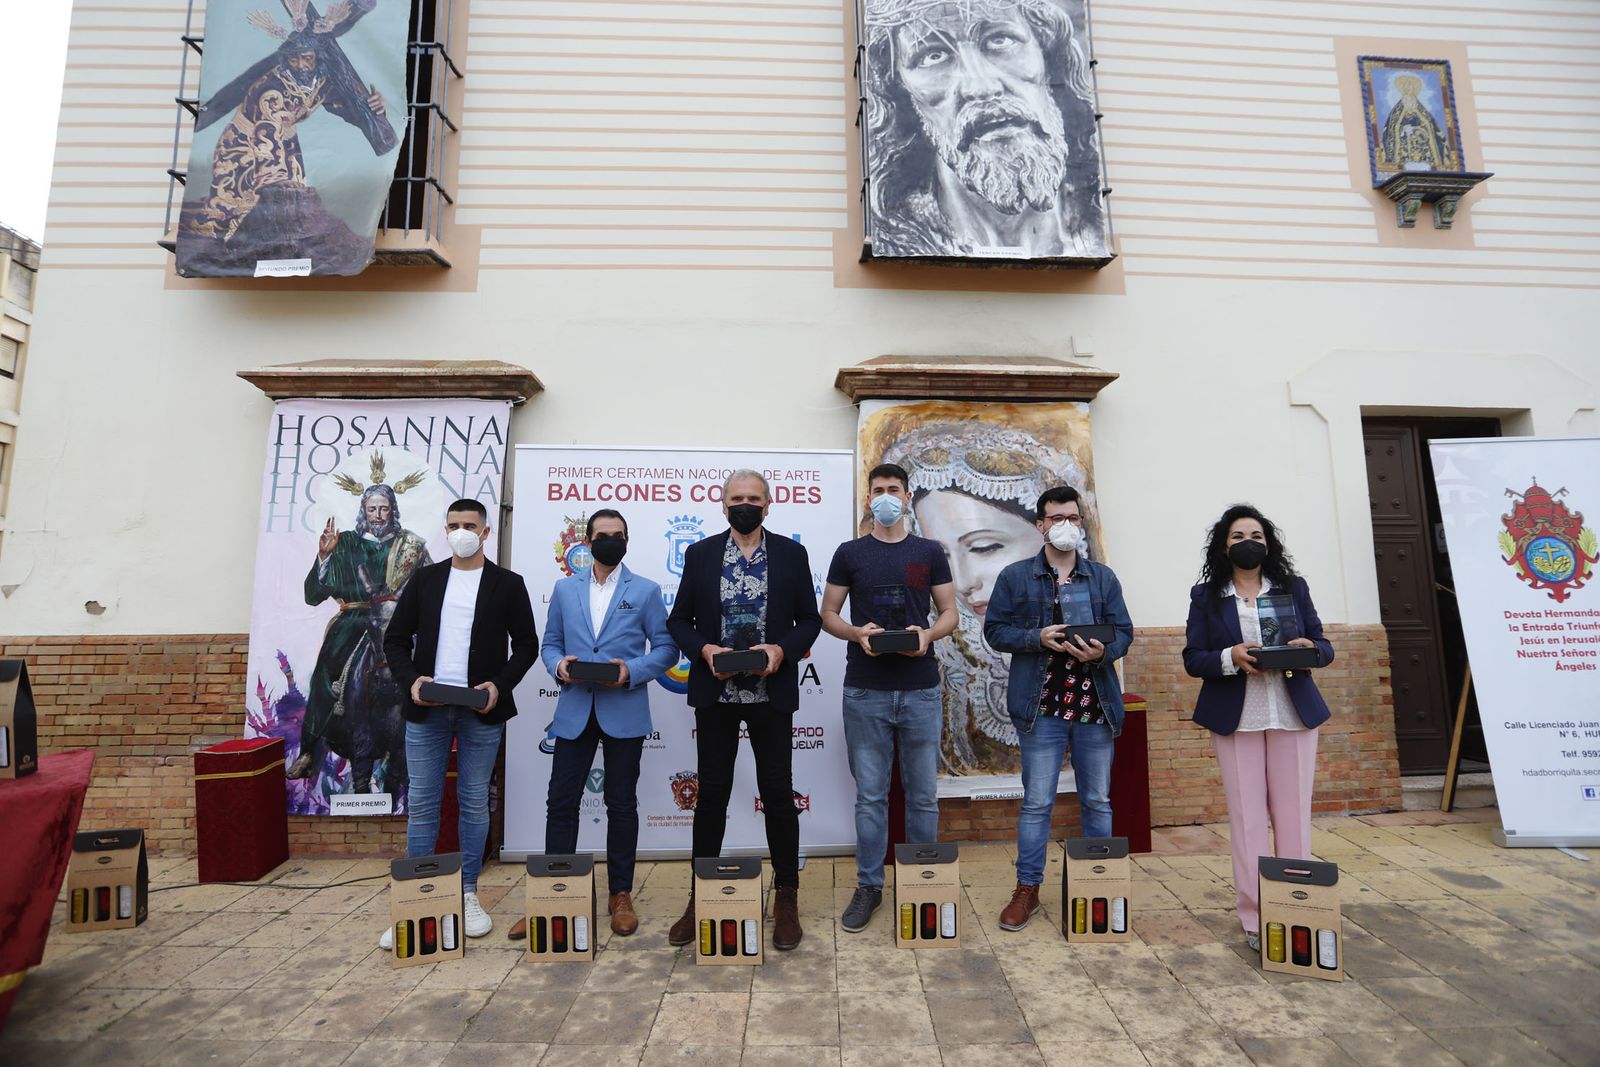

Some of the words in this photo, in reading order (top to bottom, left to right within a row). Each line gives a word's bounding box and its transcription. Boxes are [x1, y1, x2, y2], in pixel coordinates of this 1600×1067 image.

[274, 414, 504, 446] HOSANNA
[548, 466, 603, 479] PRIMER
[607, 467, 684, 479] CERTAMEN
[689, 469, 737, 480] NACIO
[763, 469, 781, 480] DE
[785, 470, 821, 481] ARTE
[547, 483, 682, 502] BALCONES
[690, 484, 822, 504] CODES
[1504, 610, 1542, 619] Devota
[1545, 608, 1600, 617] Hermanda
[1509, 624, 1519, 632] la
[1522, 623, 1564, 631] Entrada
[1520, 636, 1544, 645] Jesús
[1517, 649, 1558, 658] Nuestra
[1561, 648, 1597, 657] Señora
[1555, 660, 1597, 672] Ángeles
[1504, 721, 1526, 729] Calle
[1529, 721, 1576, 729] Licenciado
[1578, 720, 1600, 728] Juan
[792, 740, 824, 750] UELVA
[1561, 750, 1580, 758] Telf.
[1582, 750, 1600, 758] 9592
